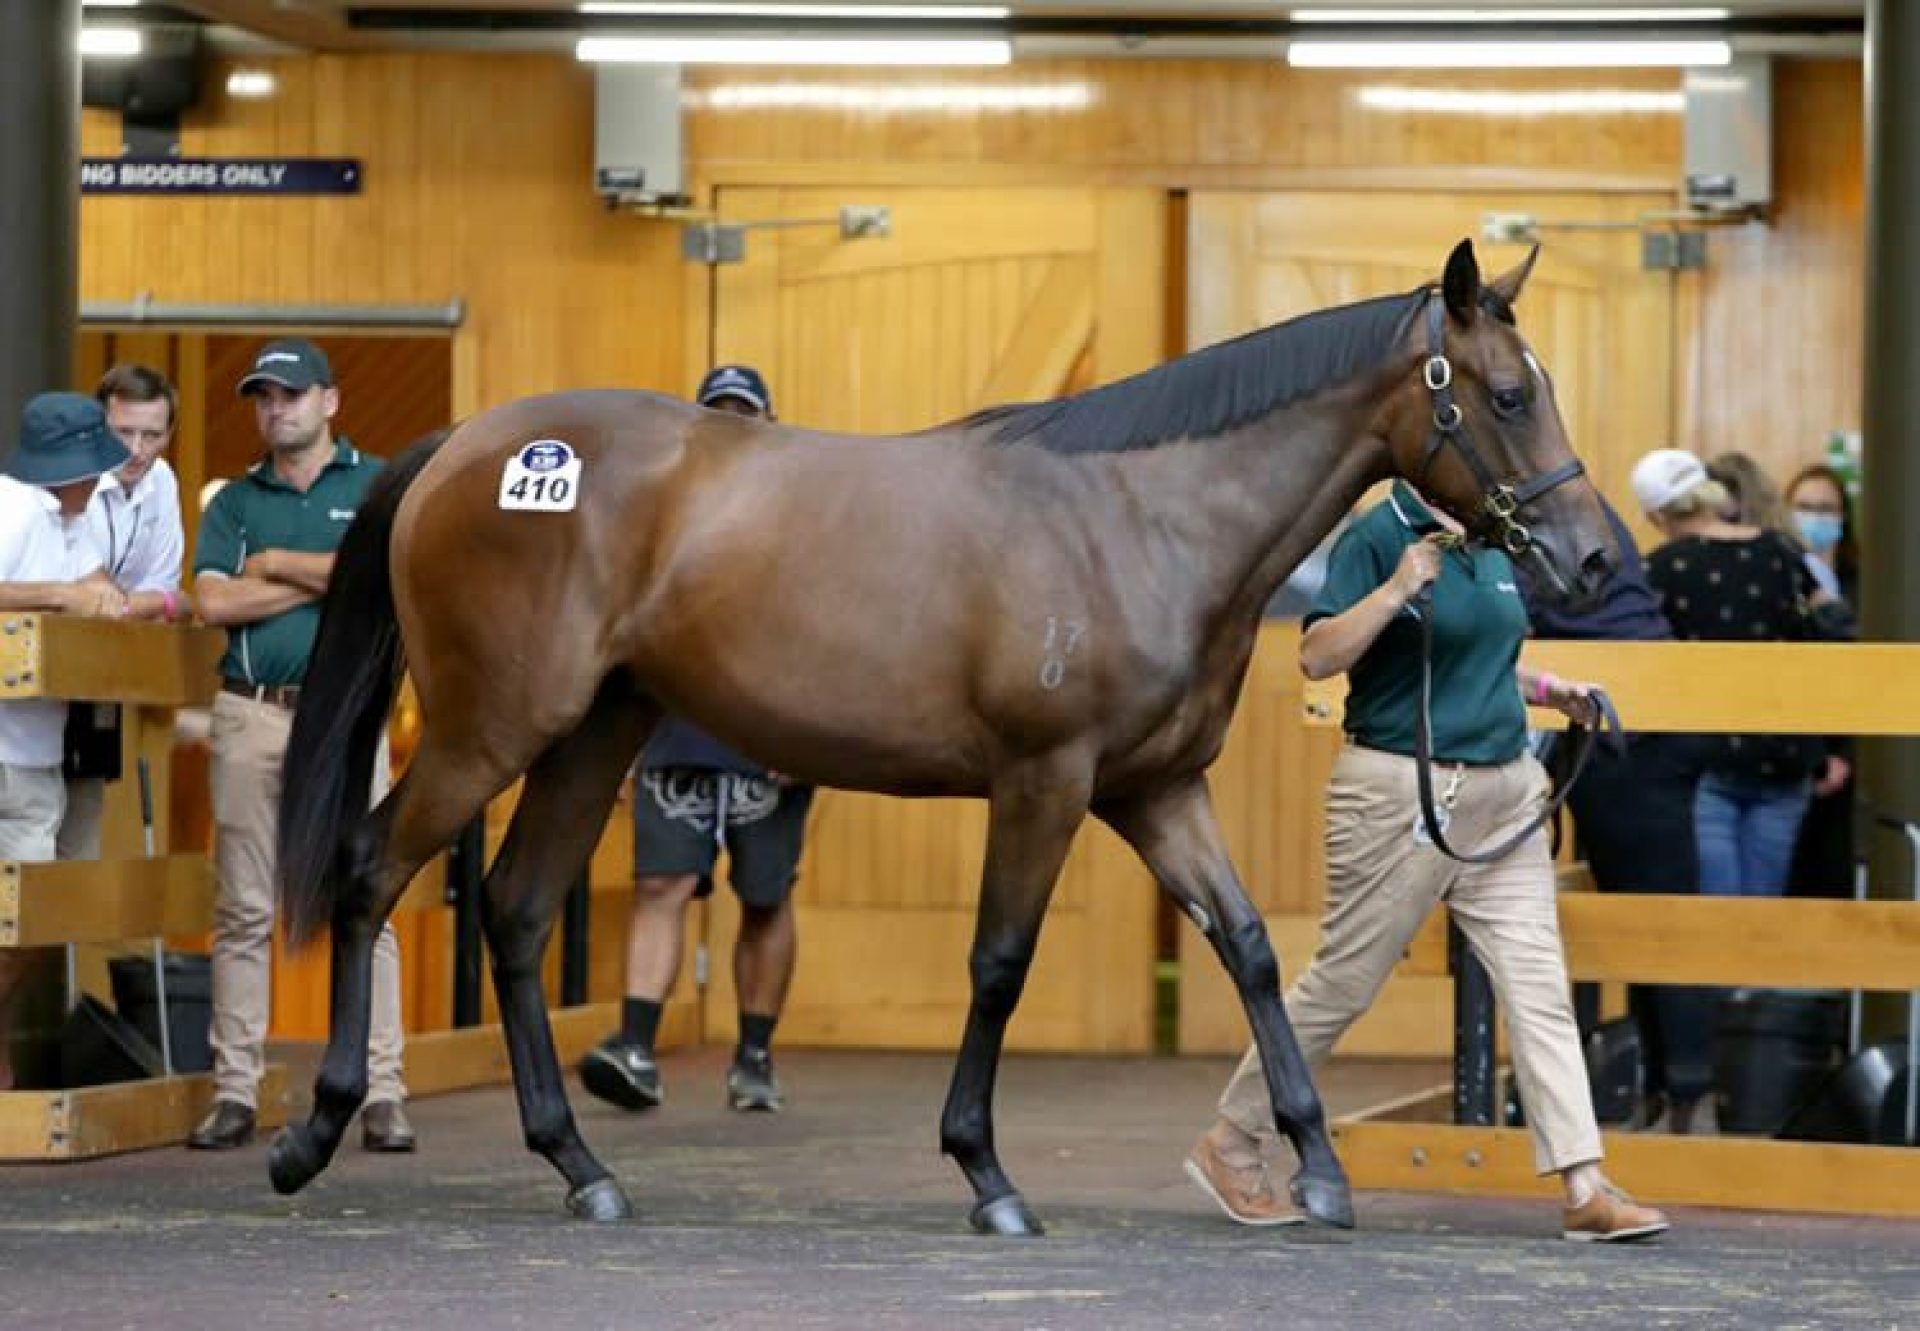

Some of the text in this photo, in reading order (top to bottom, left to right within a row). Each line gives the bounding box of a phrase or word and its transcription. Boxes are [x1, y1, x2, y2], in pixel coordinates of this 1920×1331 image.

[119, 163, 217, 187] BIDDERS
[221, 163, 287, 187] ONLY
[507, 475, 569, 502] 410
